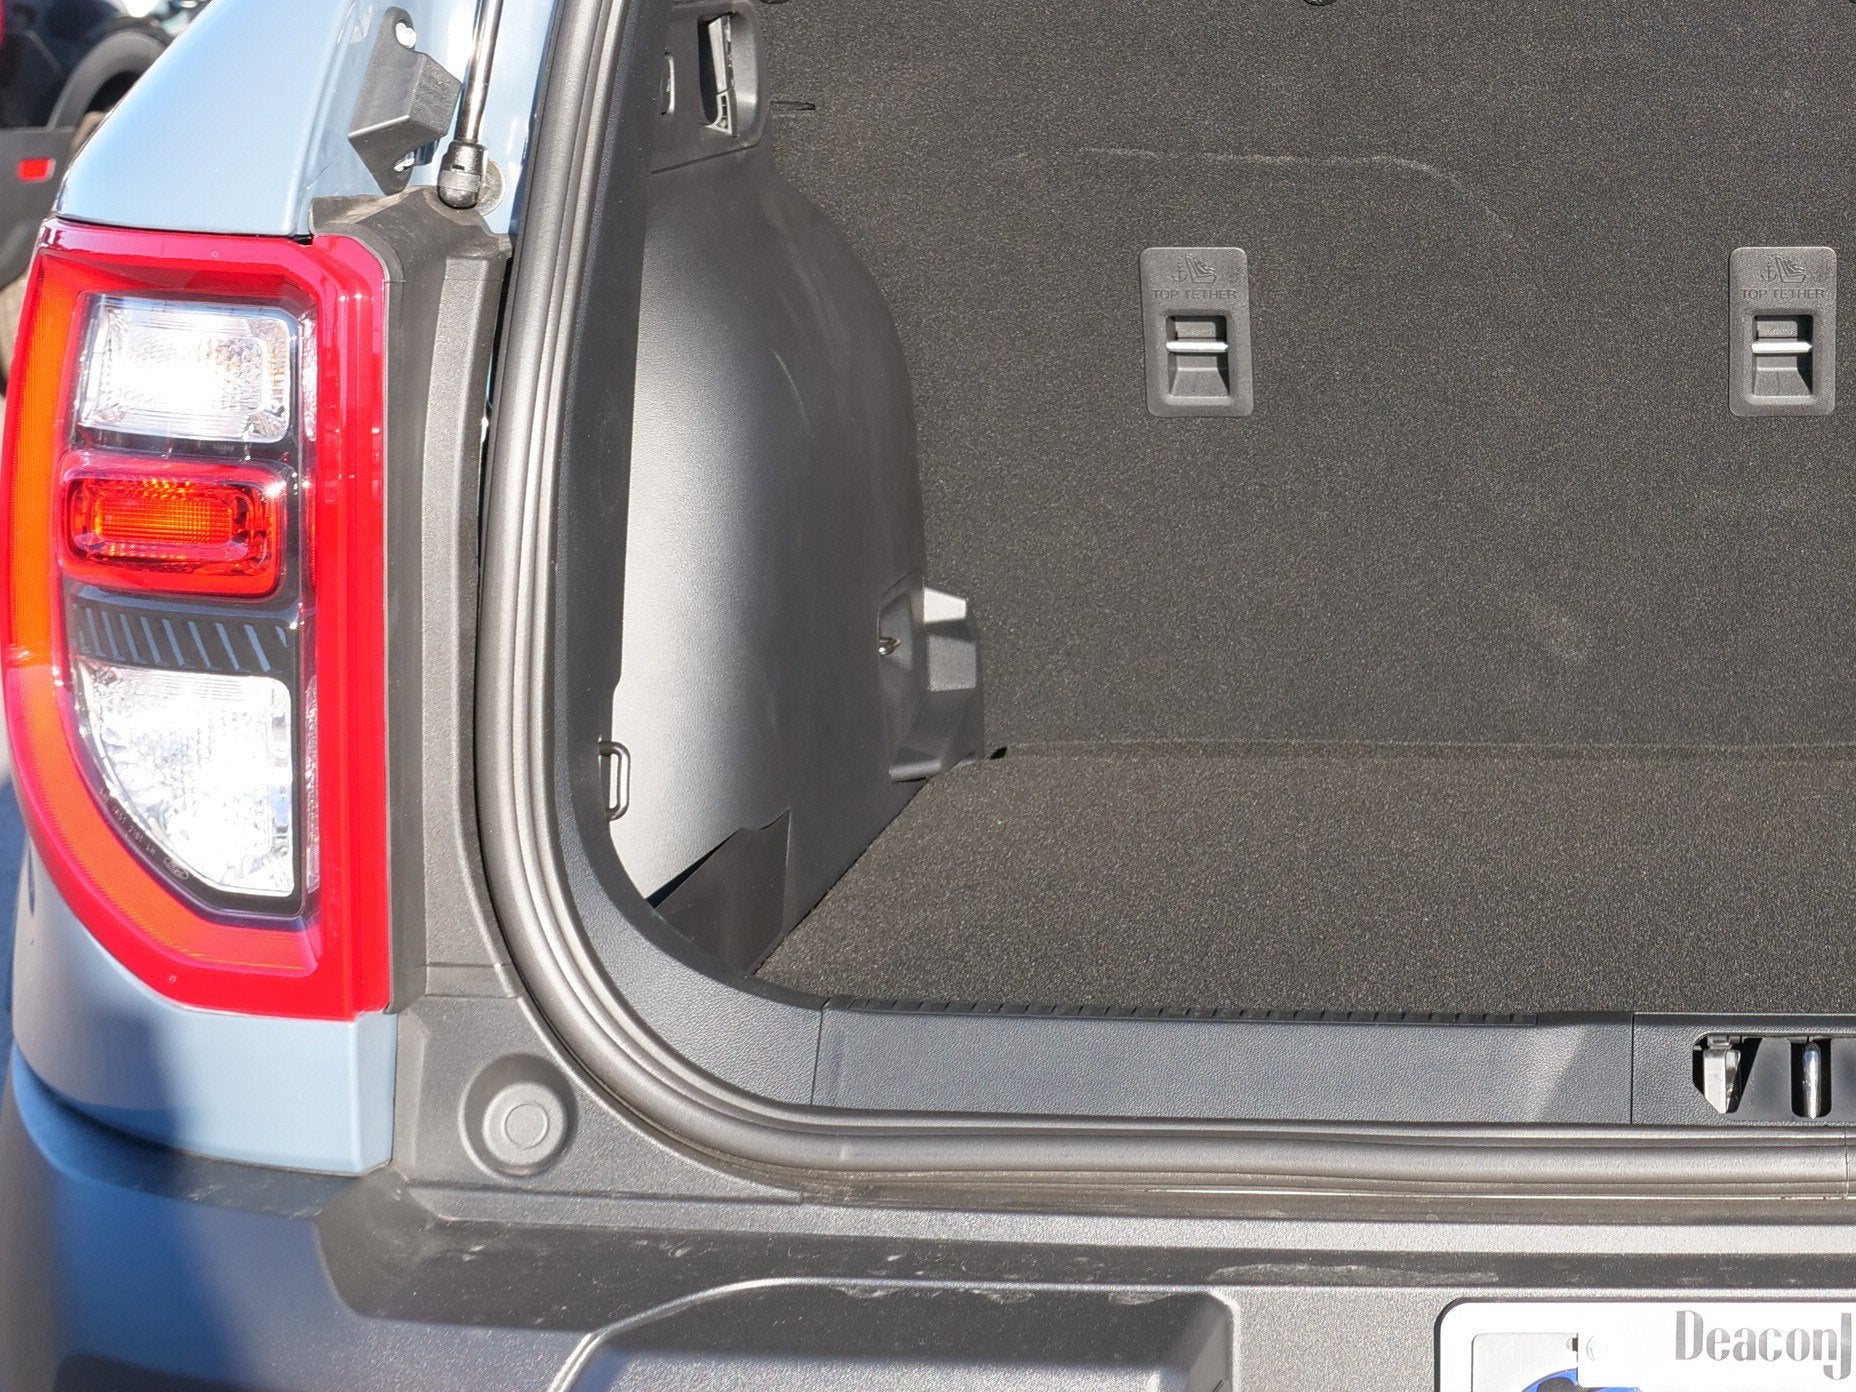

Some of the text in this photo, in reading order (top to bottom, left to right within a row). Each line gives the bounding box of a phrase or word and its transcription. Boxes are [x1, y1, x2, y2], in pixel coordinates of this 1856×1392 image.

[1151, 289, 1238, 300] TOP TETHER
[1741, 289, 1825, 299] TOP TETHER
